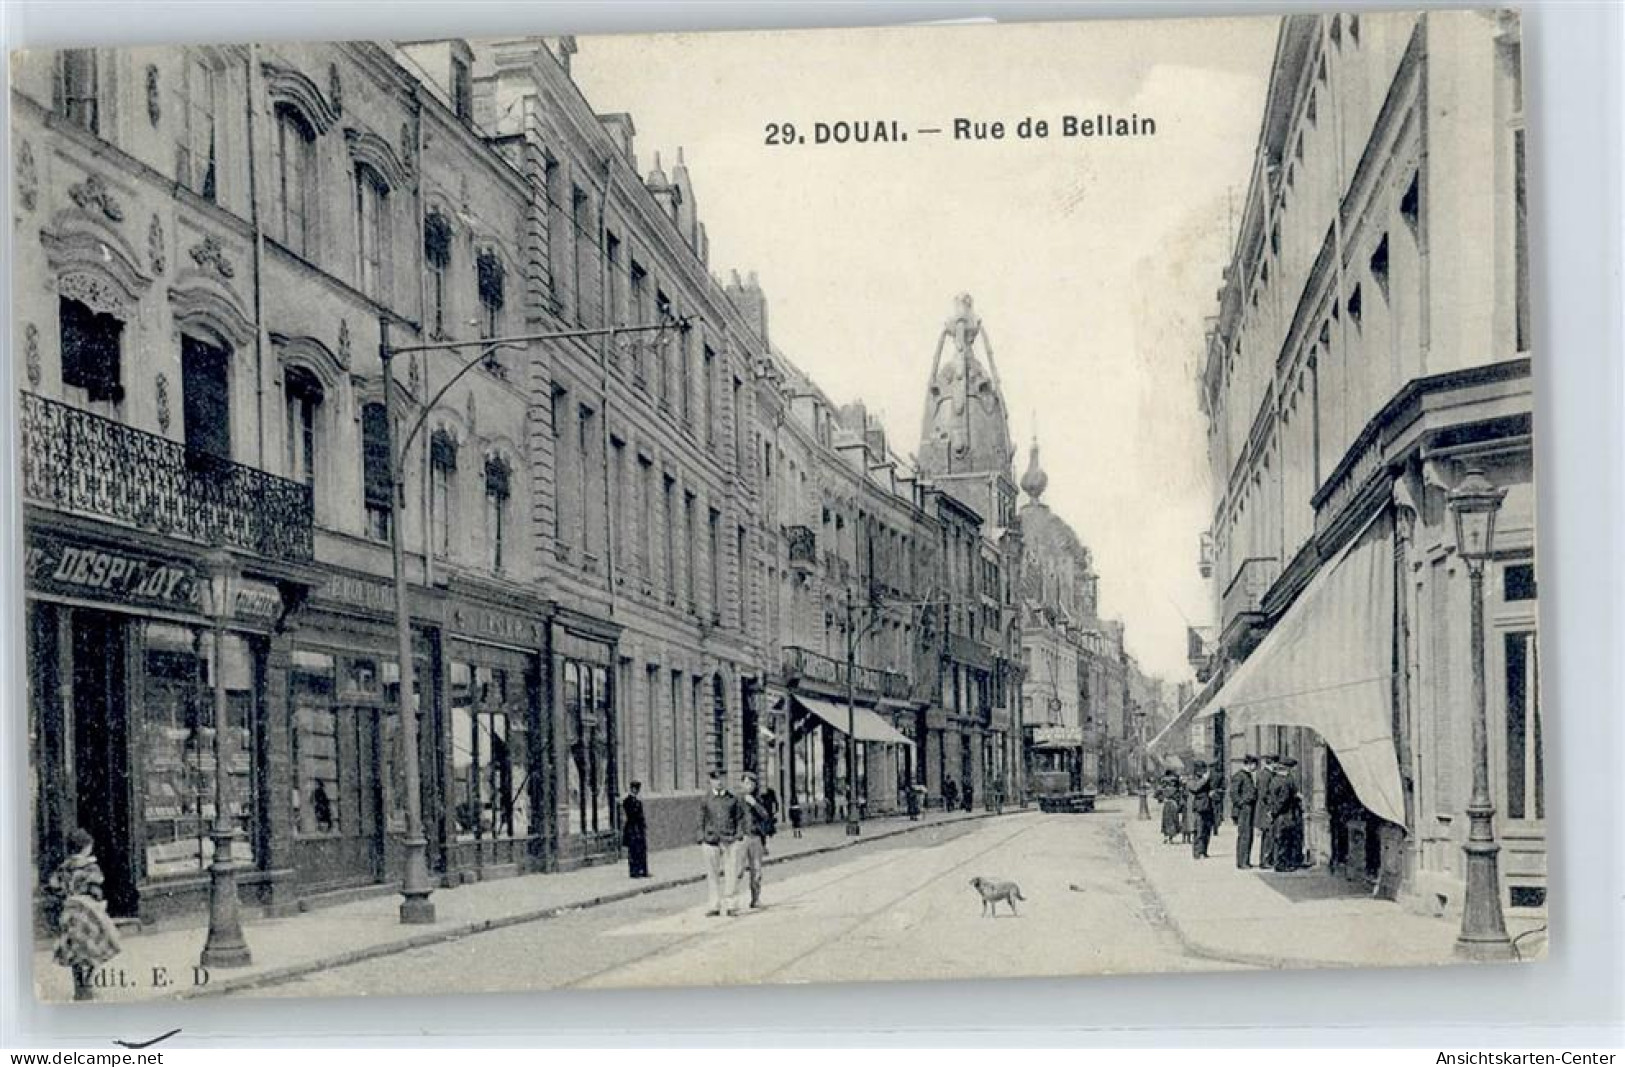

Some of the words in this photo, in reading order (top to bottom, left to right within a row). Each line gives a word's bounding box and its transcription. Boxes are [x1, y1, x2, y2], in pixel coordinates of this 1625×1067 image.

[764, 122, 805, 146] 29.
[813, 120, 909, 145] DOUAI.
[953, 117, 1005, 140] Rue
[1016, 116, 1050, 139] de
[1062, 113, 1157, 137] Bellain
[151, 966, 175, 988] E.
[192, 966, 211, 987] D
